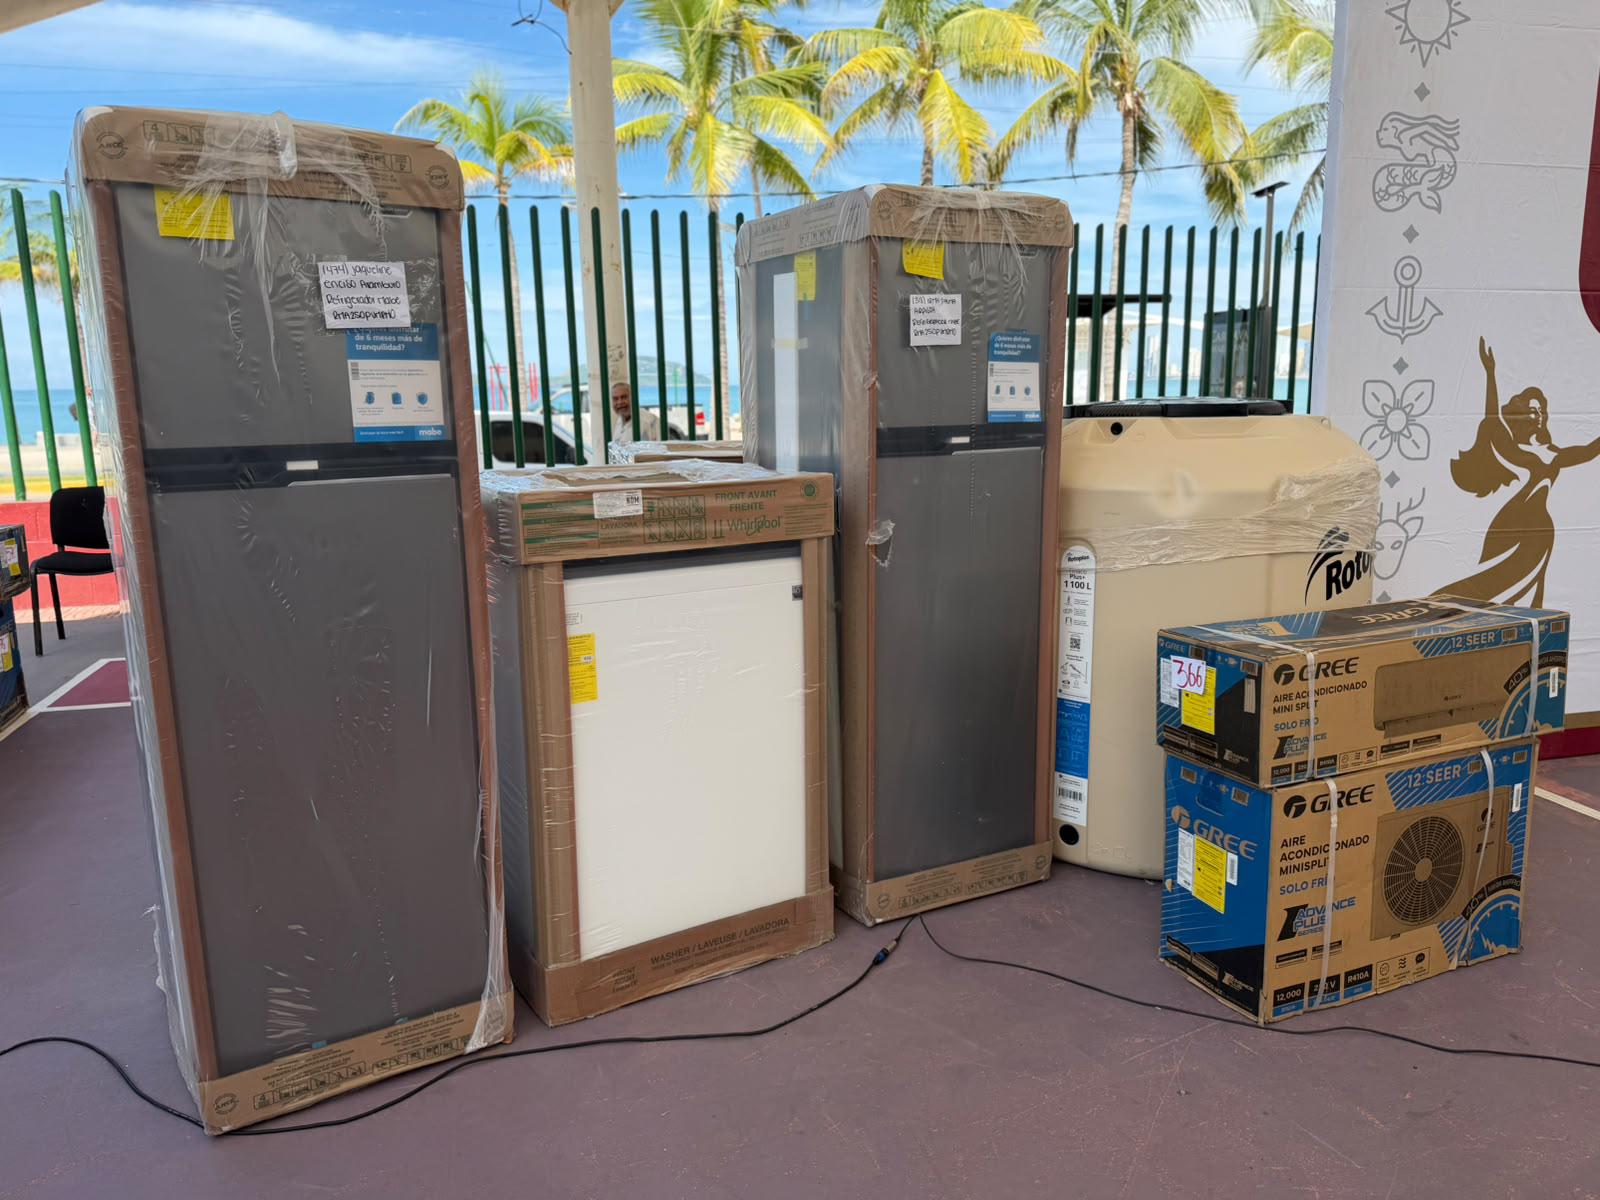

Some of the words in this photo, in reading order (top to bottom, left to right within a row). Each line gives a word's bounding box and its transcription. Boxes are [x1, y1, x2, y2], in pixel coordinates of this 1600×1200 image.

[355, 343, 405, 352] tranquilidad?
[715, 491, 744, 501] FRONT
[747, 489, 777, 499] AVANT
[729, 502, 765, 512] FRENTE
[727, 515, 781, 536] Whirlpool
[1326, 545, 1374, 600] Roto
[1086, 582, 1092, 590] L
[1465, 631, 1496, 646] SEER
[1165, 641, 1186, 653] GREE
[1172, 659, 1203, 689] 366
[1299, 656, 1360, 681] GREE
[1273, 692, 1294, 704] AIRE
[1273, 704, 1293, 715] MINI
[1274, 721, 1298, 732] SOLO
[1299, 717, 1319, 728] FRO
[1426, 764, 1462, 785] SEER
[1310, 784, 1376, 813] GREE
[1193, 818, 1259, 861] GREE
[1281, 835, 1306, 849] AIRE
[1280, 834, 1370, 862] ACONDICONADO
[1280, 857, 1329, 876] MINISPLI
[1279, 881, 1309, 895] SOLO
[1294, 915, 1326, 930] PLUS
[650, 946, 690, 965] WASHER
[698, 932, 737, 950] LAVEUSE
[744, 918, 789, 937] LAVADORA
[1347, 971, 1369, 983] R410A
